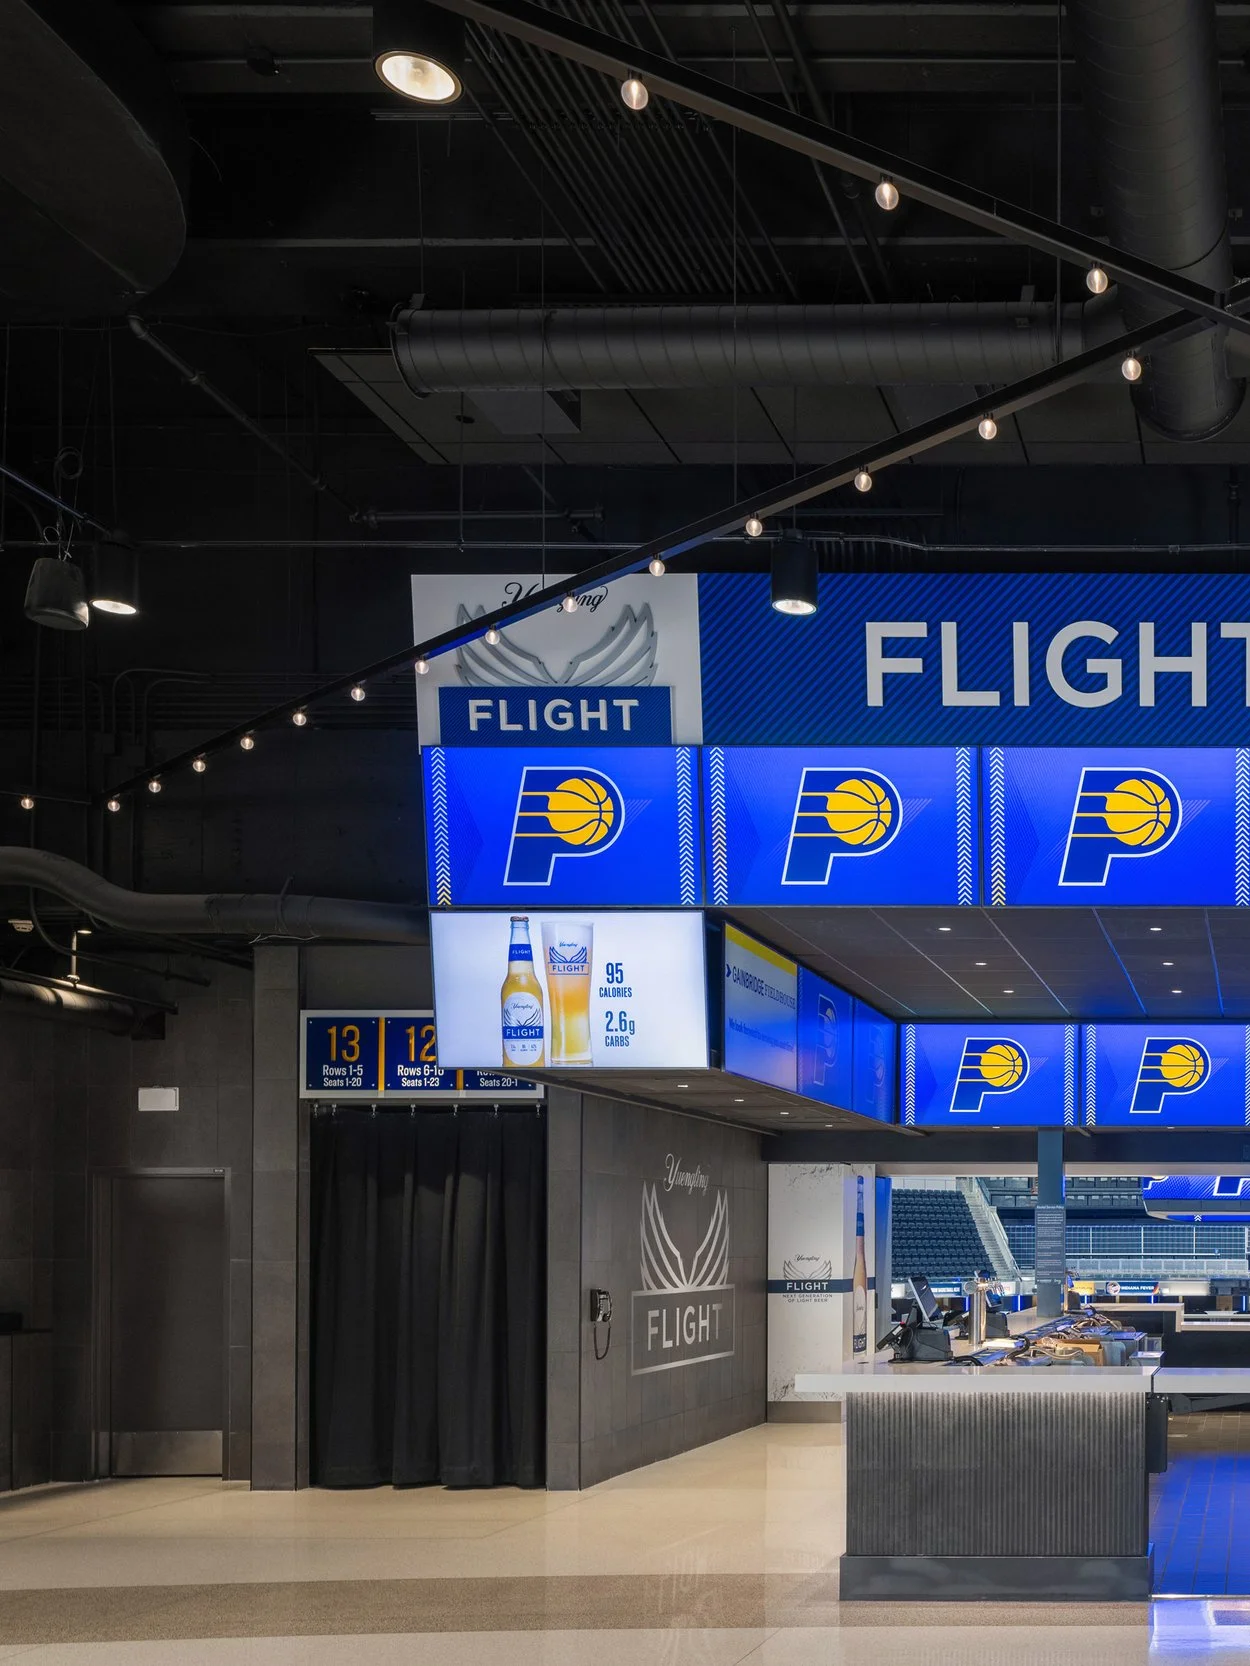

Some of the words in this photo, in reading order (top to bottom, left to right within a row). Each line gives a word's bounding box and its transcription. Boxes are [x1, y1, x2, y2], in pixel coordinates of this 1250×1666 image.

[468, 699, 640, 731] FLIGHT
[552, 964, 585, 973] FLIGHT
[605, 962, 624, 984] 95
[732, 966, 764, 996] GAINBRIDGE
[599, 986, 633, 998] CALORIES
[605, 1010, 635, 1035] 2.6g
[506, 1028, 540, 1037] FLIGHT
[327, 1025, 360, 1062] 13
[405, 1025, 437, 1062] 12
[605, 1036, 630, 1047] CARBS
[322, 1065, 348, 1076] Rows
[349, 1065, 363, 1076] 1-5
[397, 1065, 422, 1076] Rows
[323, 1077, 344, 1087] Seats
[345, 1077, 362, 1087] 1-20
[401, 1077, 422, 1087] Seats
[423, 1077, 440, 1087] 1-23
[479, 1077, 500, 1087] Seats
[501, 1077, 518, 1087] 20-1
[663, 1153, 709, 1196] Yuengling
[786, 1281, 829, 1291] FLIGHT
[647, 1303, 723, 1351] FLIGHT
